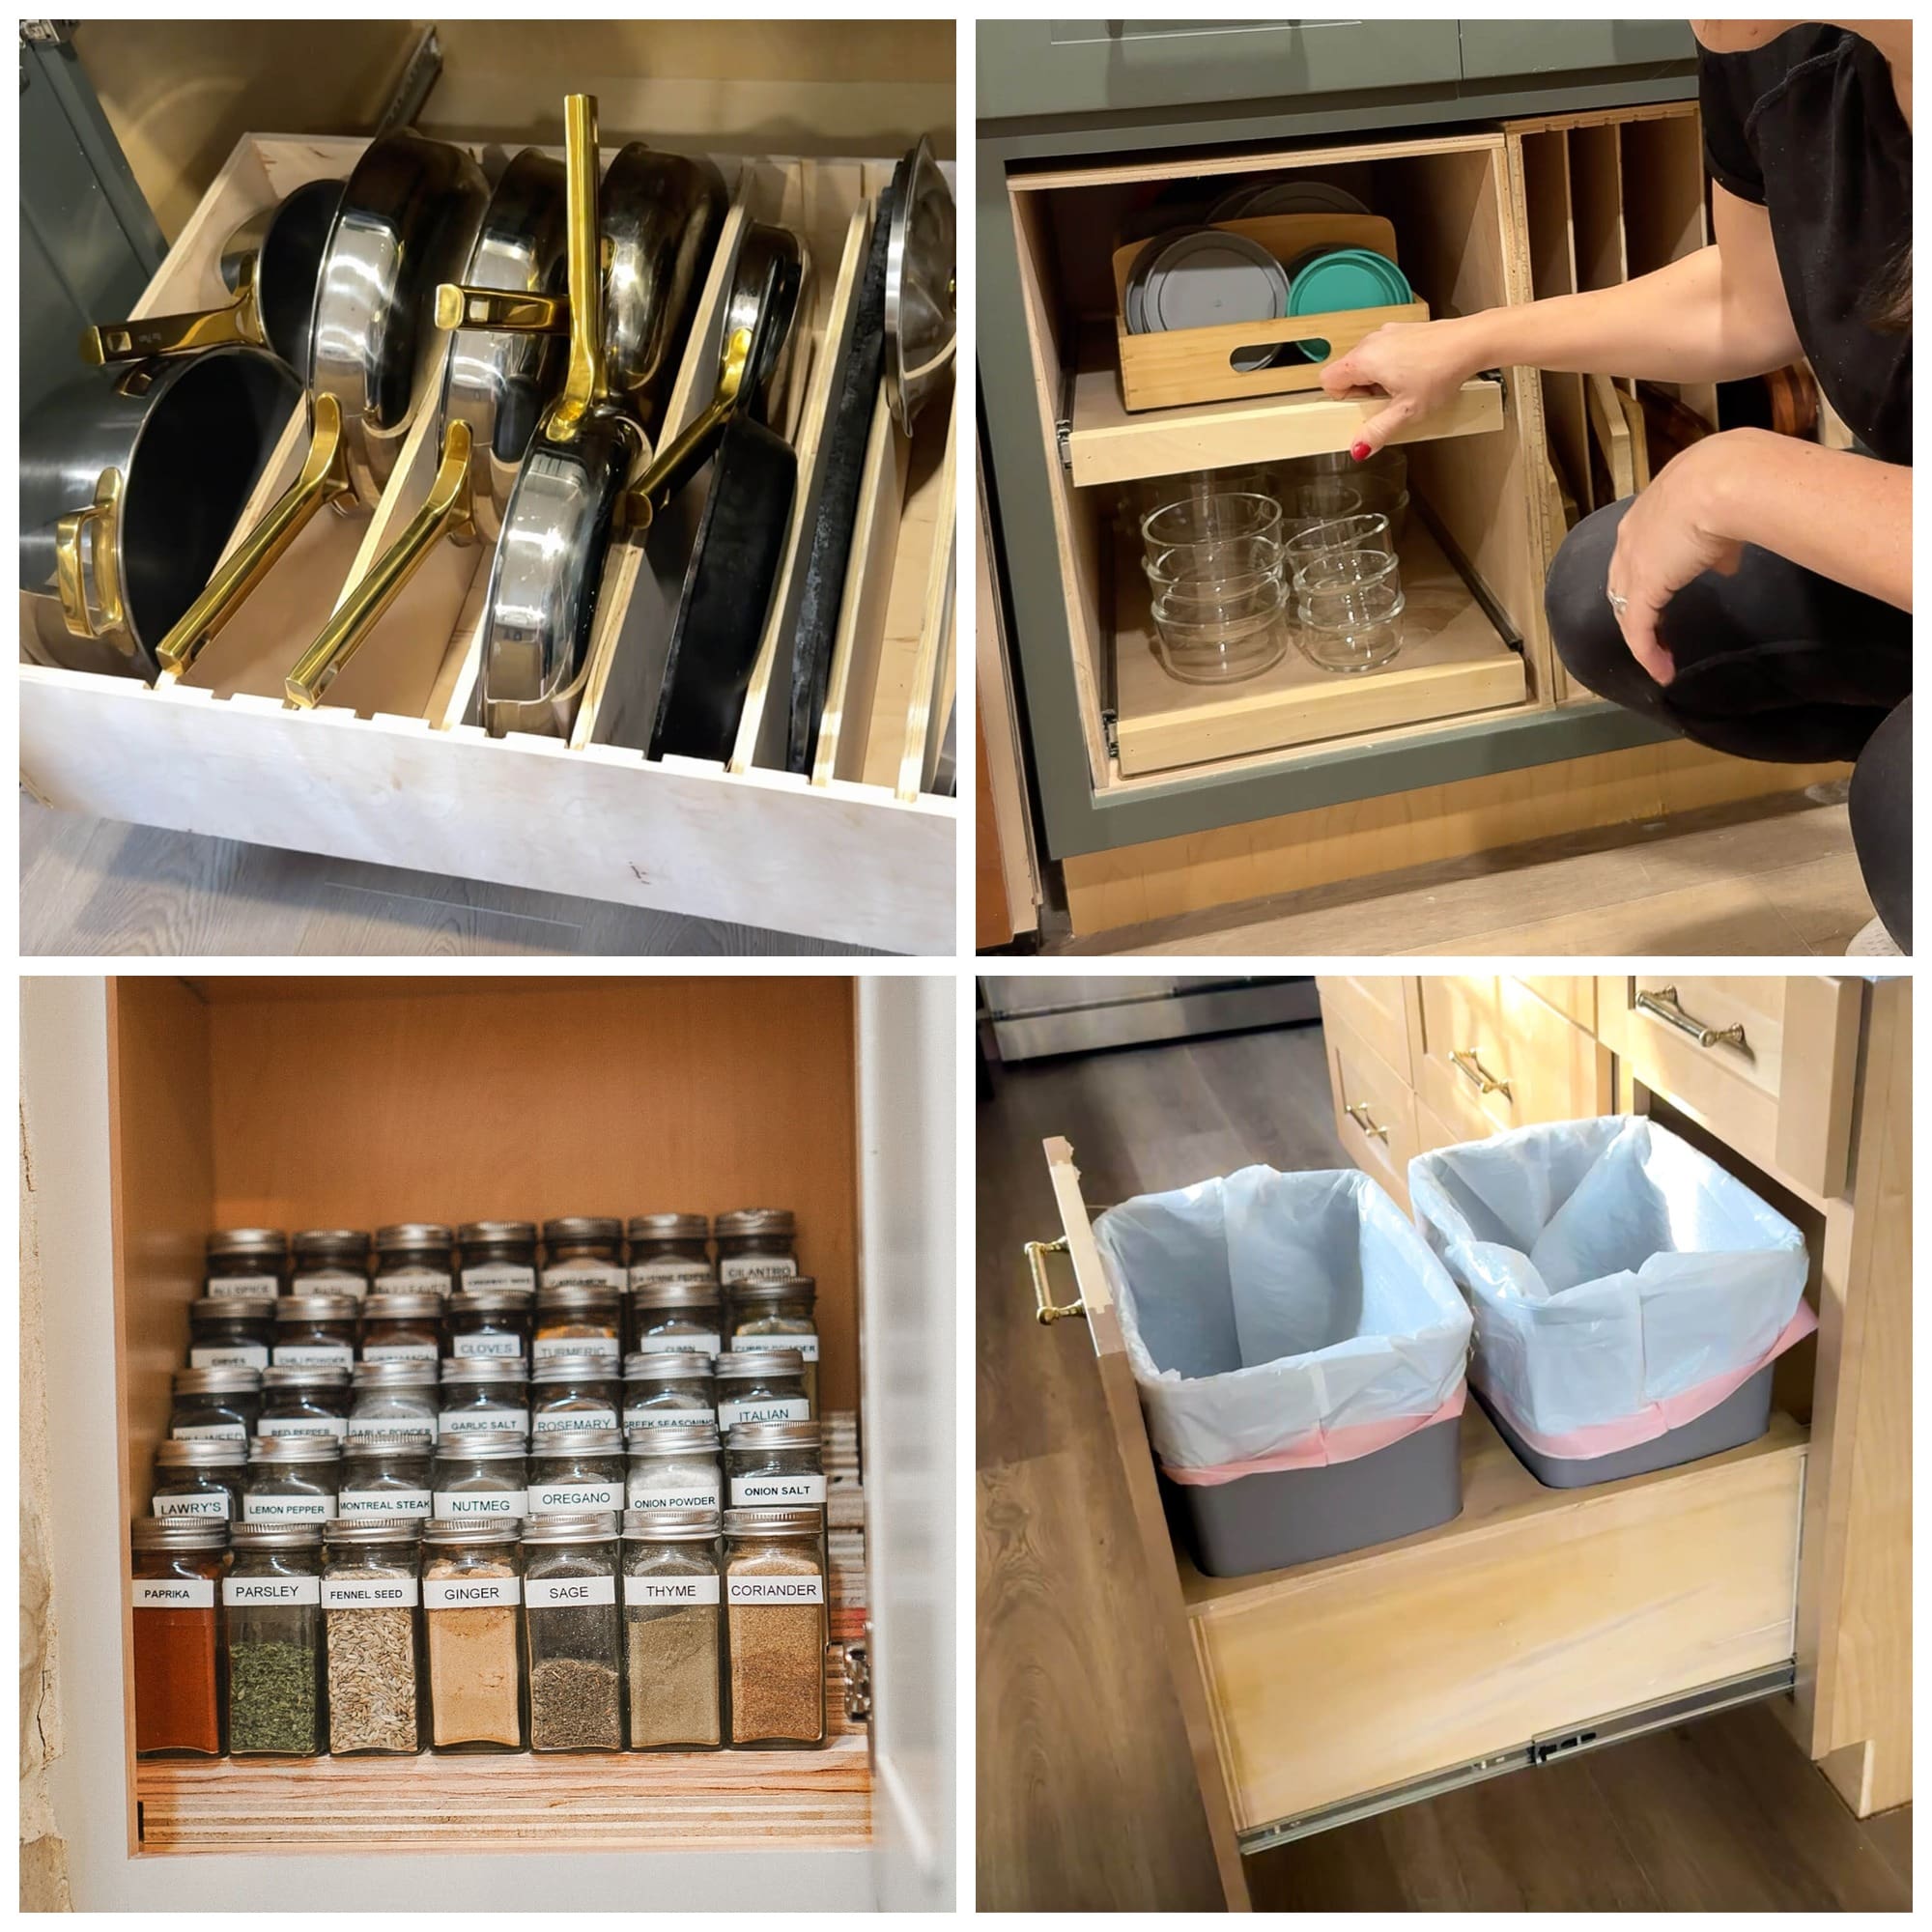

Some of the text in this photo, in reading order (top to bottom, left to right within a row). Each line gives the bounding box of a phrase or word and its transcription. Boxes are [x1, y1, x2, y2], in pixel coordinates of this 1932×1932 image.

[728, 1266, 791, 1276] CILANTRO
[460, 1343, 513, 1355] CLOVES
[541, 1346, 606, 1357] TURMERIC
[739, 1407, 790, 1423] ITALIAN
[450, 1420, 518, 1431] GARLIC SALT
[537, 1418, 611, 1432] ROSEMARY
[293, 1428, 330, 1436] PEPPER
[744, 1486, 811, 1496] ONION SALT
[541, 1492, 611, 1505] OREGANO
[634, 1496, 716, 1509] ONION POWDER
[160, 1501, 222, 1516] LAWRY'S
[249, 1505, 326, 1515] LEMON PEPPER
[339, 1500, 430, 1511] MONTREAL STEAK
[451, 1499, 511, 1512] NUTMEG
[144, 1589, 191, 1600] PAPRIKA
[235, 1585, 299, 1599] PARSLEY
[329, 1589, 404, 1601] FENNEL SEED
[443, 1586, 500, 1601] GINGER
[549, 1585, 589, 1600] SAGE
[645, 1585, 697, 1598] THYME
[730, 1584, 817, 1598] CORIANDER
